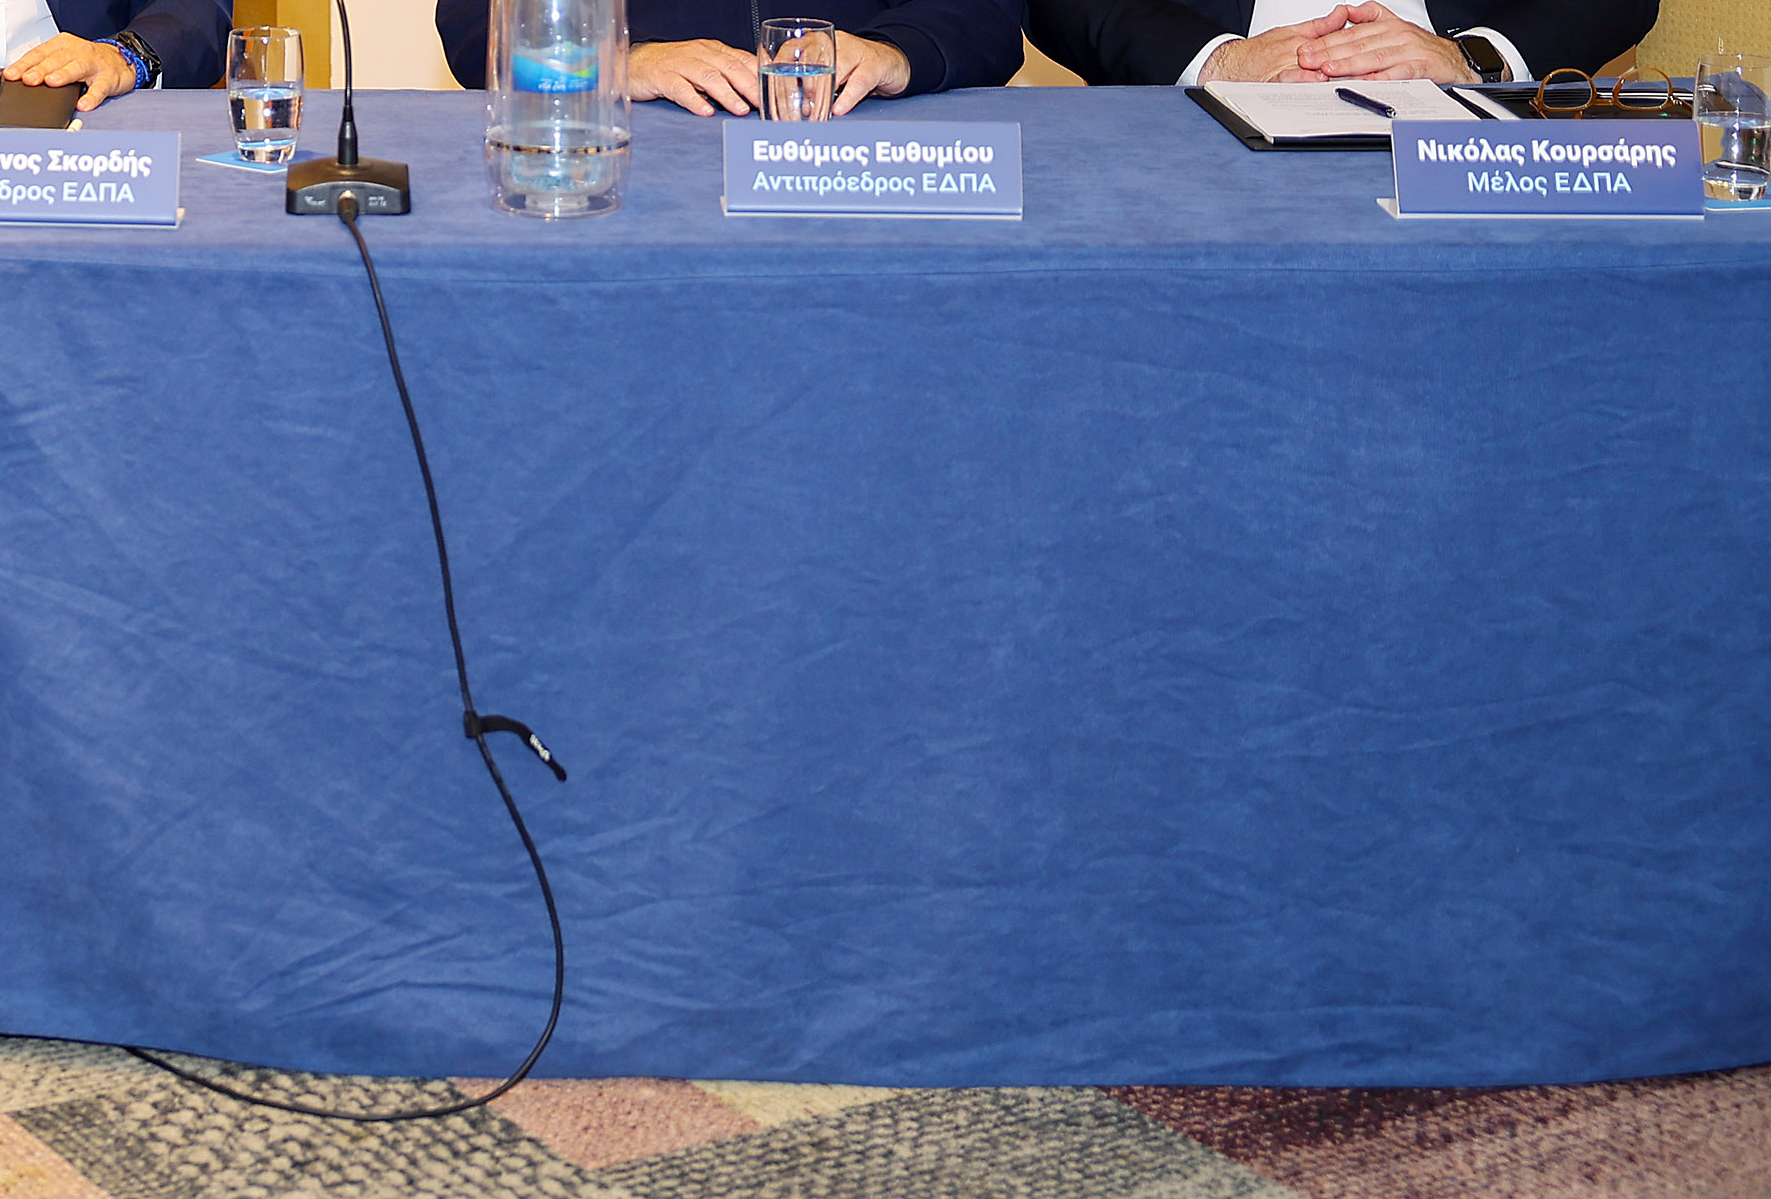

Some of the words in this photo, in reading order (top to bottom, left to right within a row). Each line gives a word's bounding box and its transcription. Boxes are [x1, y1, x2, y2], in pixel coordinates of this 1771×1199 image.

[46, 149, 153, 177] Σκορδής
[752, 139, 870, 167] Ευθύμιος
[875, 140, 995, 168] Ευθυμίου
[1417, 138, 1526, 167] Νικόλας
[1531, 138, 1677, 168] Κουρσάρης
[62, 181, 135, 203] ΕΔΠΑ
[752, 171, 915, 196] Αντιπρόεδρος
[922, 172, 997, 193] ΕΔΠΑ
[1467, 170, 1548, 197] Μέλος
[1554, 171, 1633, 194] ΕΔΠΑ
